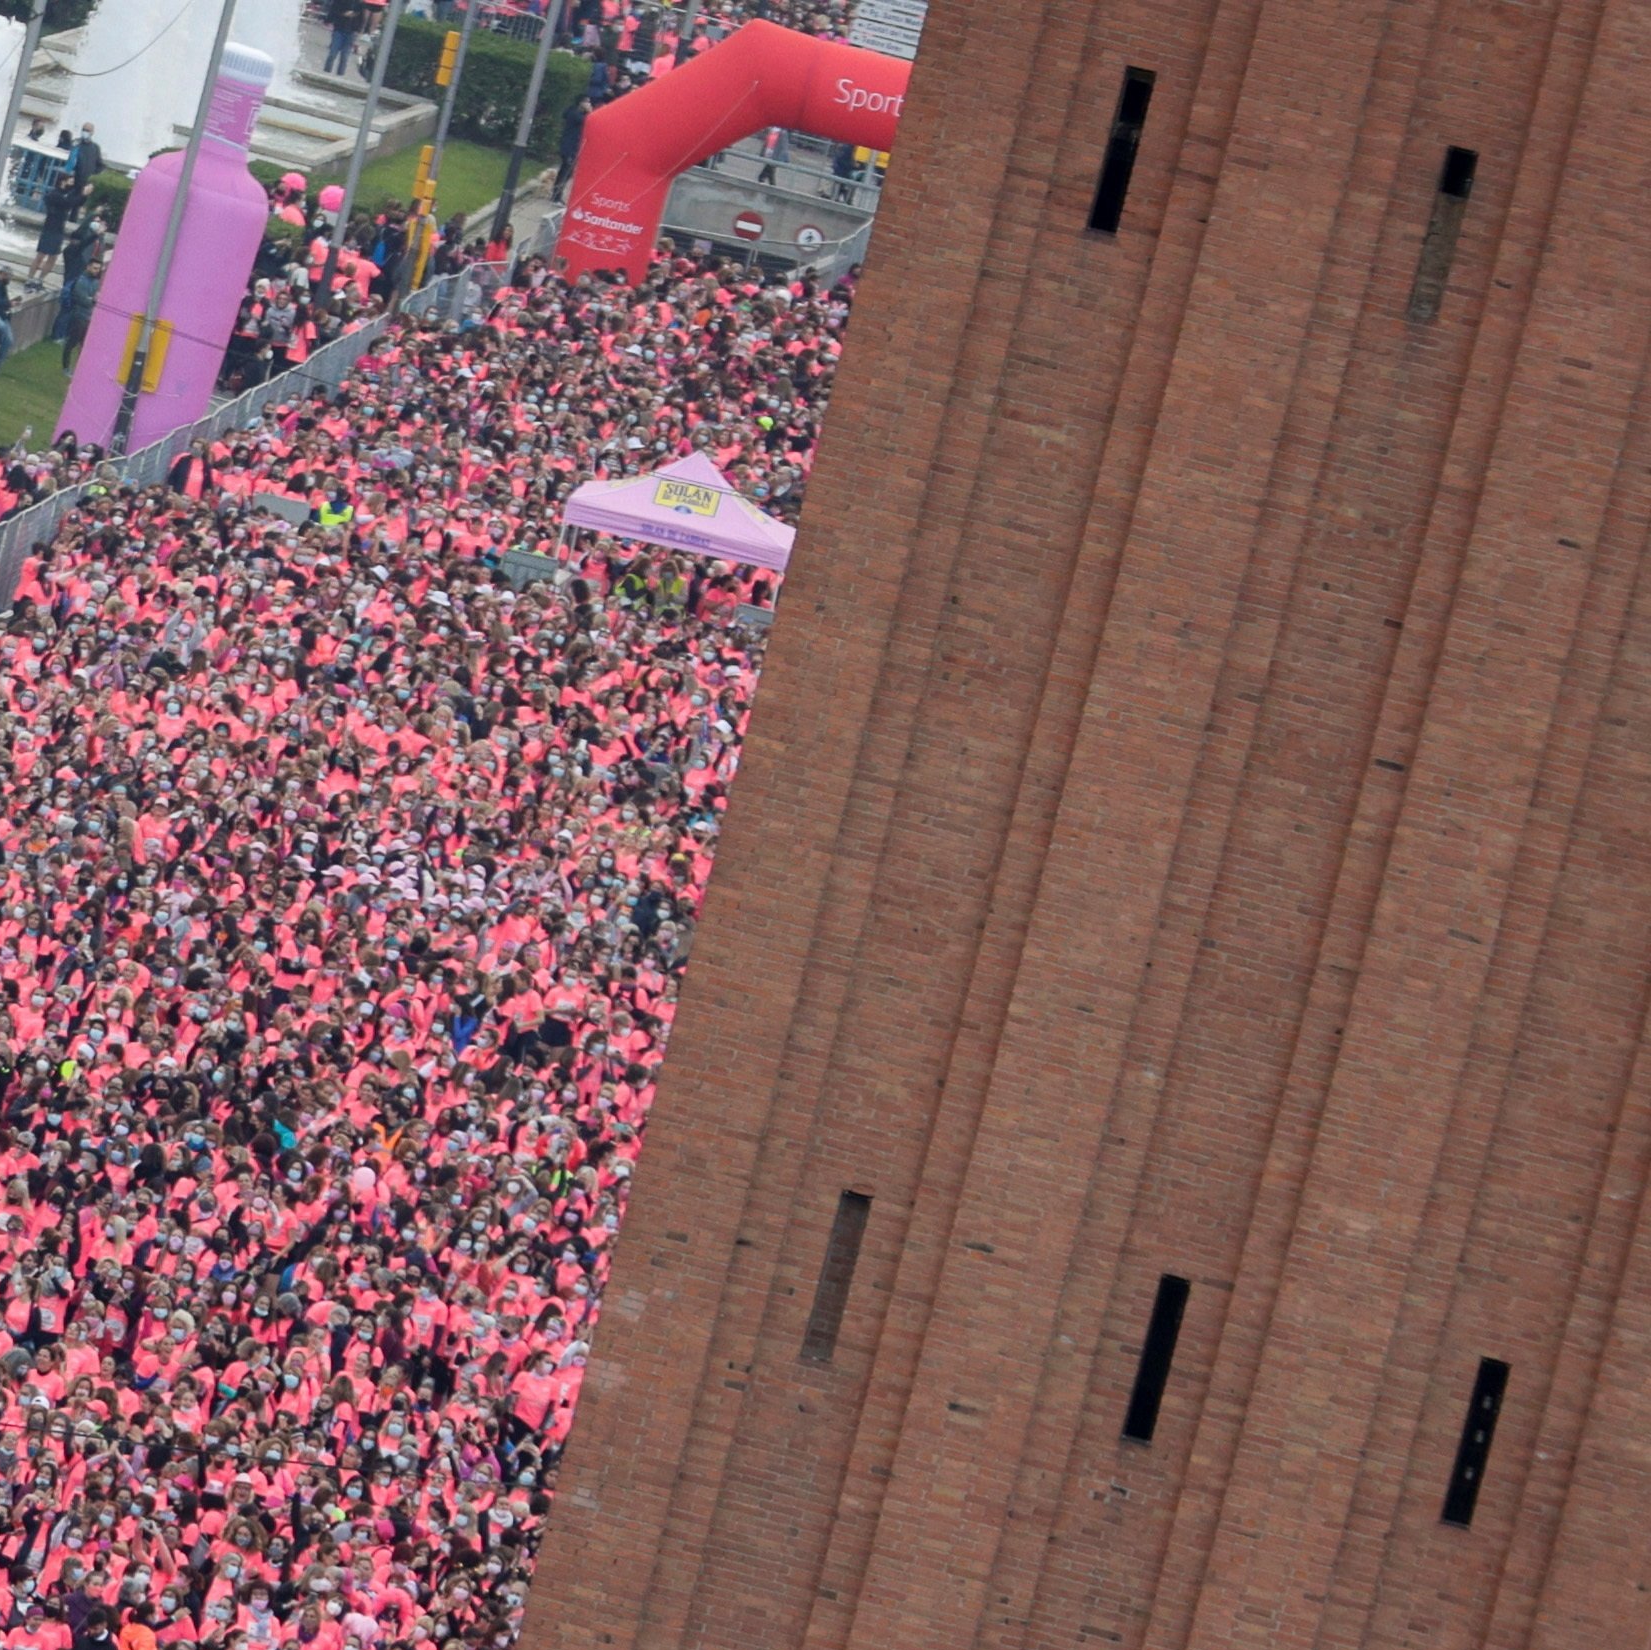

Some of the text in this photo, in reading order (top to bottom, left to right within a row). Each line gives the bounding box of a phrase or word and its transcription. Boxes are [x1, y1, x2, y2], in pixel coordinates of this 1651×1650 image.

[591, 193, 631, 212] Sports
[584, 211, 643, 234] Santander
[666, 483, 713, 503] SOLAN
